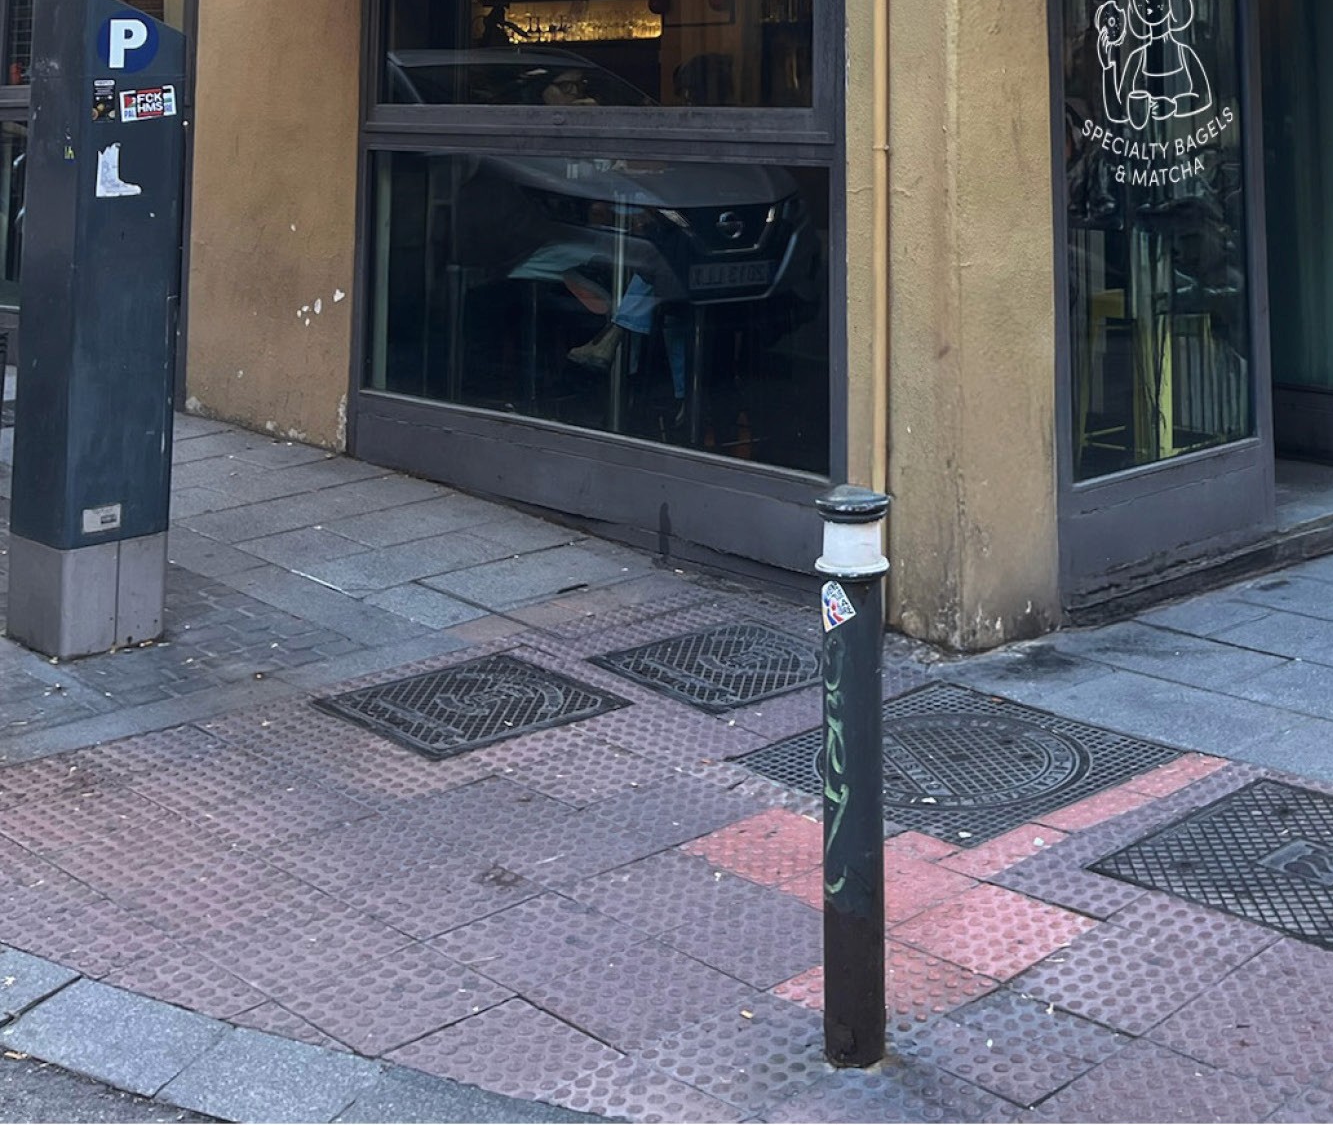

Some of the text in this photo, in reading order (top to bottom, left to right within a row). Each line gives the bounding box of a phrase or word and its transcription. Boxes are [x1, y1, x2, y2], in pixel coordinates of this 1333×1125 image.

[109, 18, 148, 69] P
[137, 92, 163, 104] FCK
[137, 102, 163, 113] HMS
[1081, 106, 1234, 160] SPECIALTY BAGELS
[1115, 156, 1205, 187] & MATCHA
